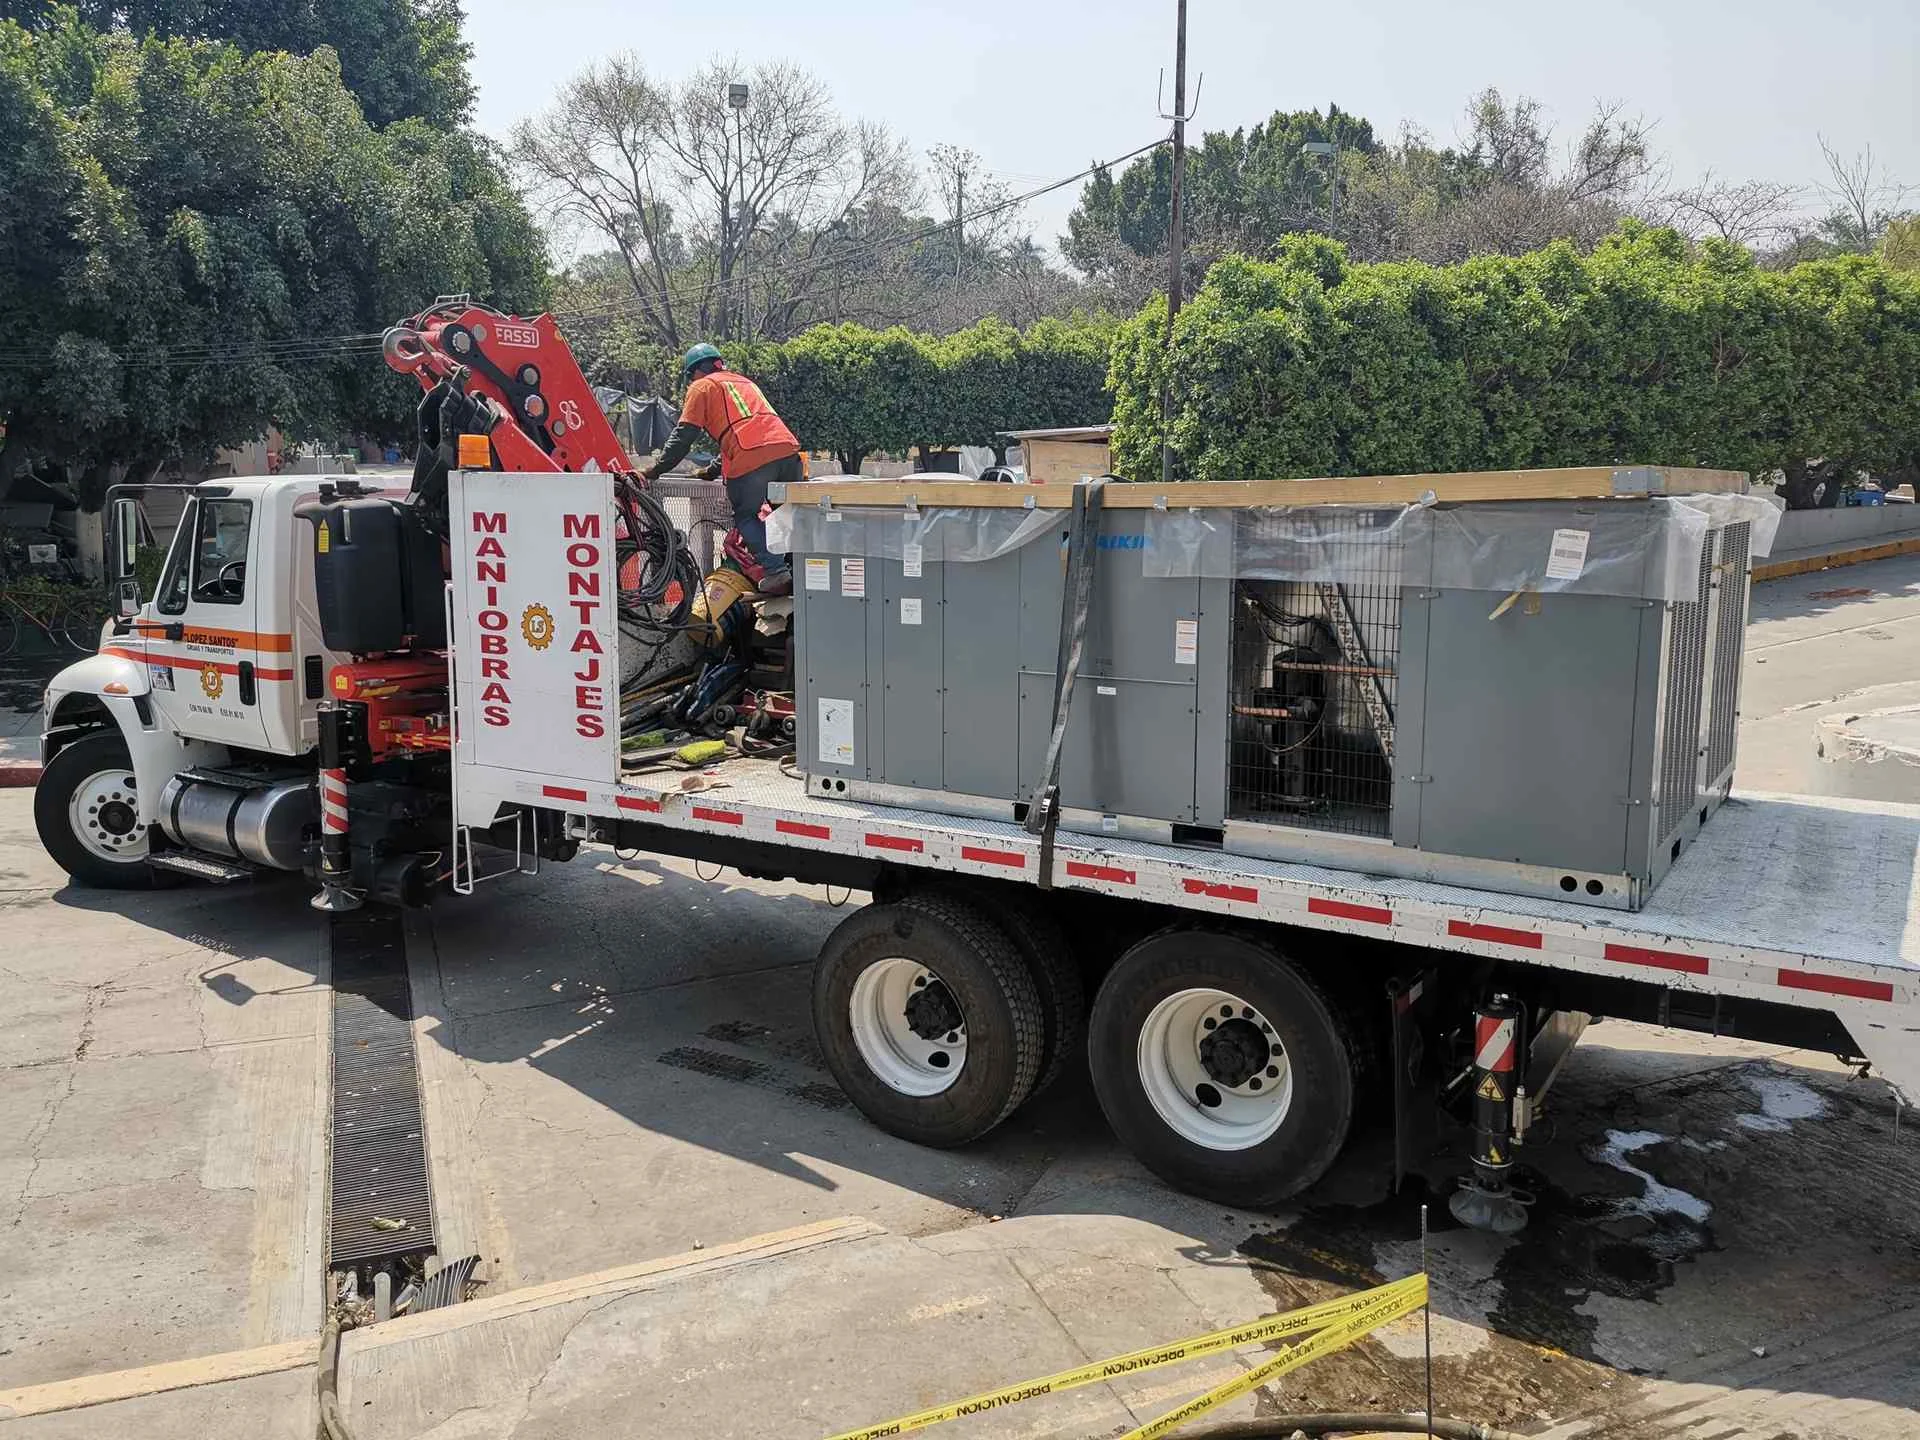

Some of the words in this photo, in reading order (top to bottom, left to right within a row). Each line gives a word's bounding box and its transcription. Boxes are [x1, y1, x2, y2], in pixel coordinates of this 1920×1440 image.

[495, 327, 536, 345] FASSI
[472, 511, 511, 727] MANIOBRAS
[562, 514, 605, 738] MONTAJES
[1231, 1316, 1309, 1345] PRECAUCION
[1103, 1349, 1185, 1377] PRECAUCION
[956, 1382, 1051, 1417] PRECAUCION
